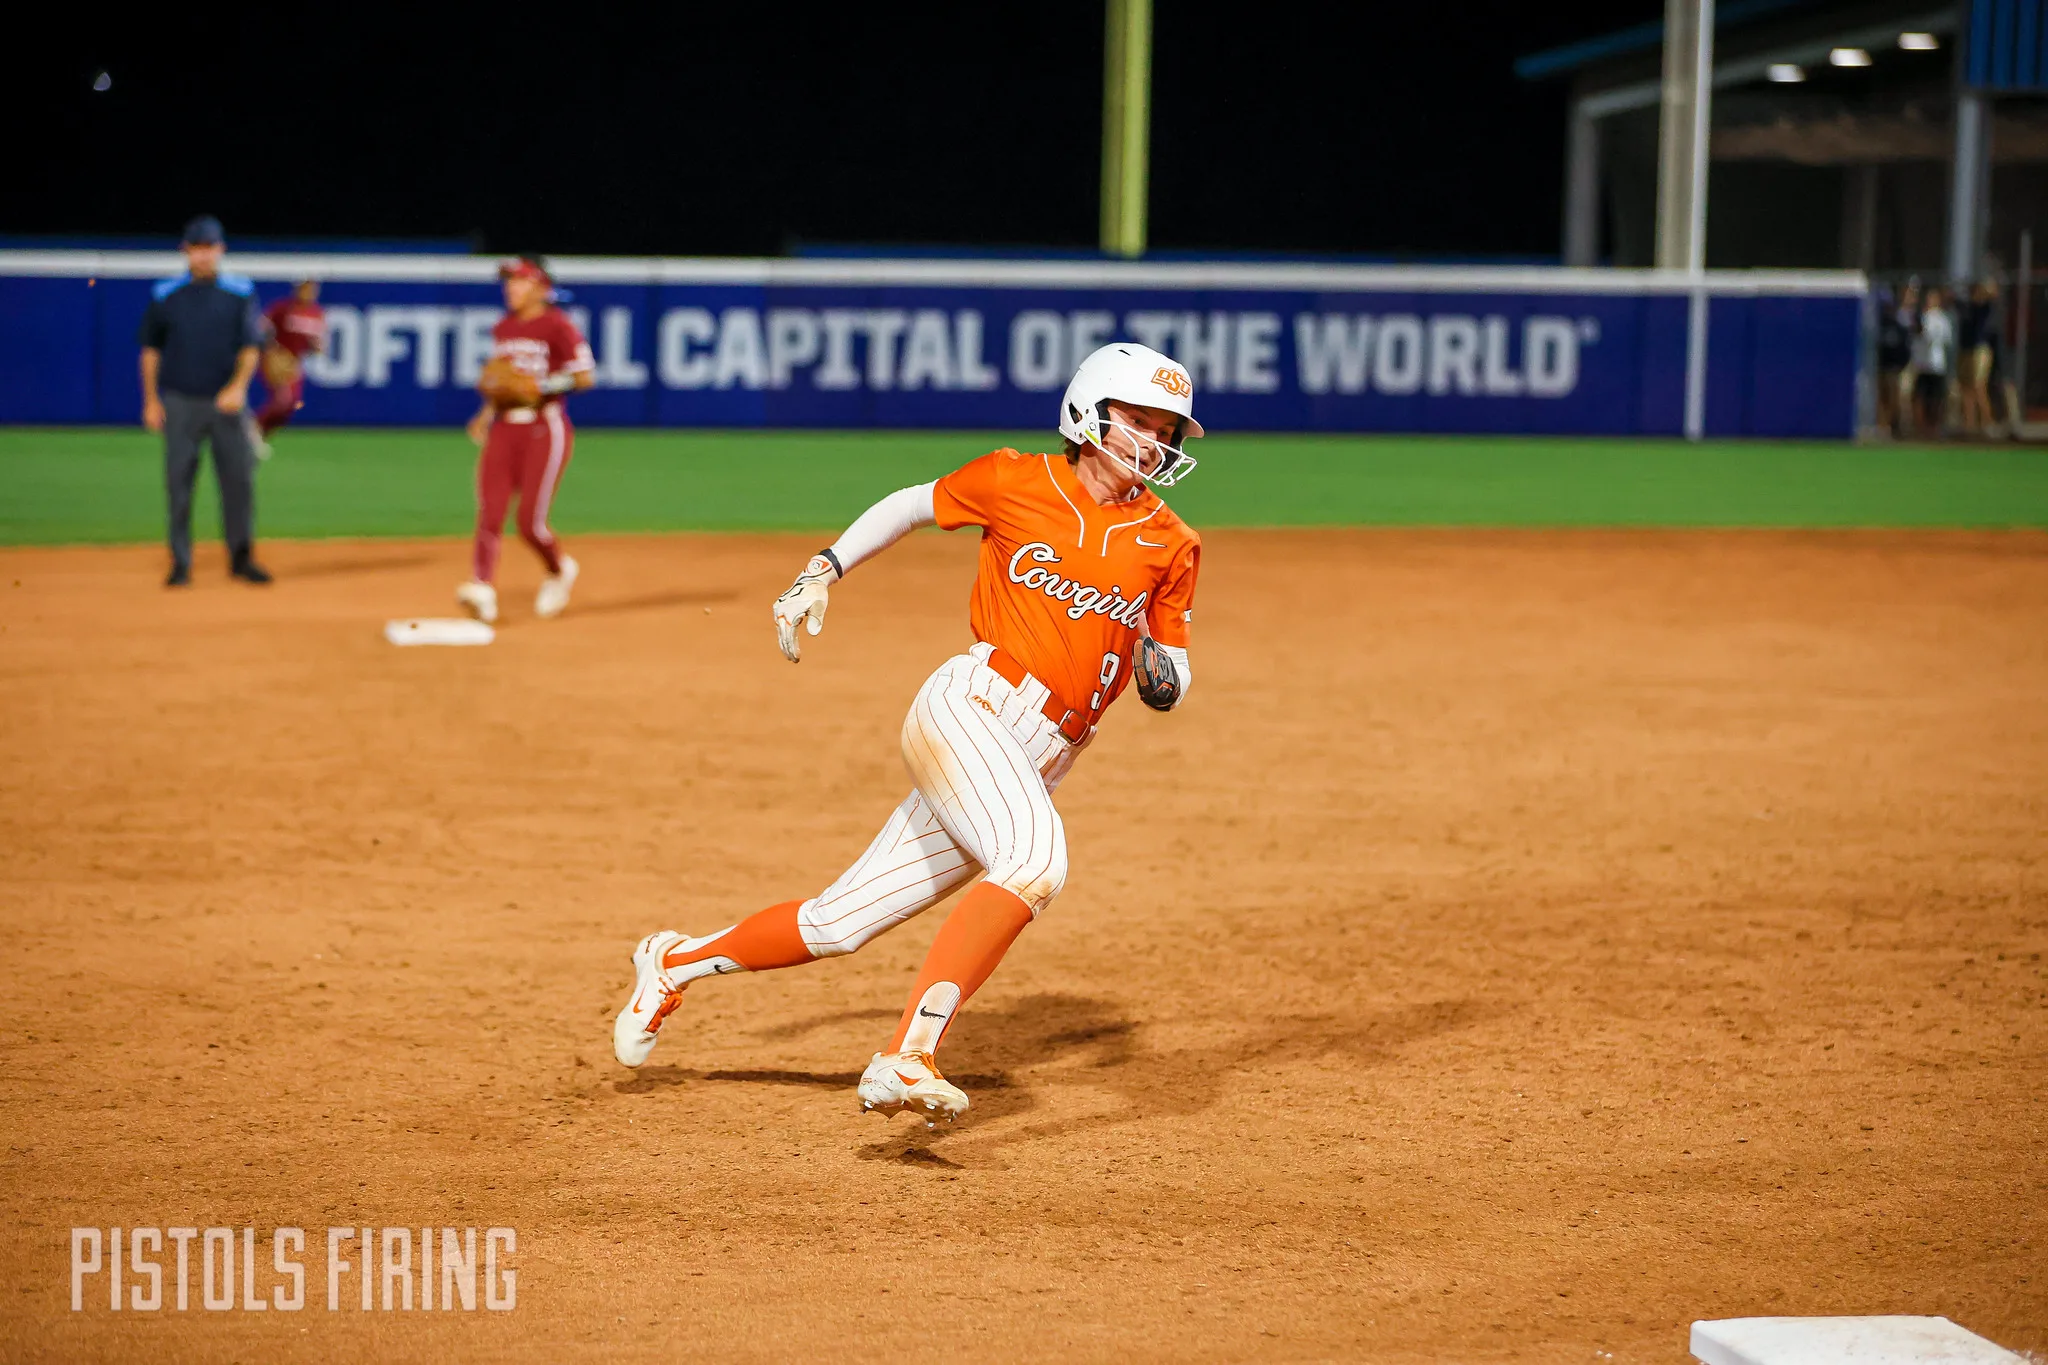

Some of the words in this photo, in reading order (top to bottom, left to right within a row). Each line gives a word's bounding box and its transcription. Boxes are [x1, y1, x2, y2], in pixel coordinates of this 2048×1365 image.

[658, 306, 997, 391] CAPITAL
[1008, 309, 1116, 393] OF
[1125, 309, 1283, 396] THE
[1090, 652, 1120, 711] 9
